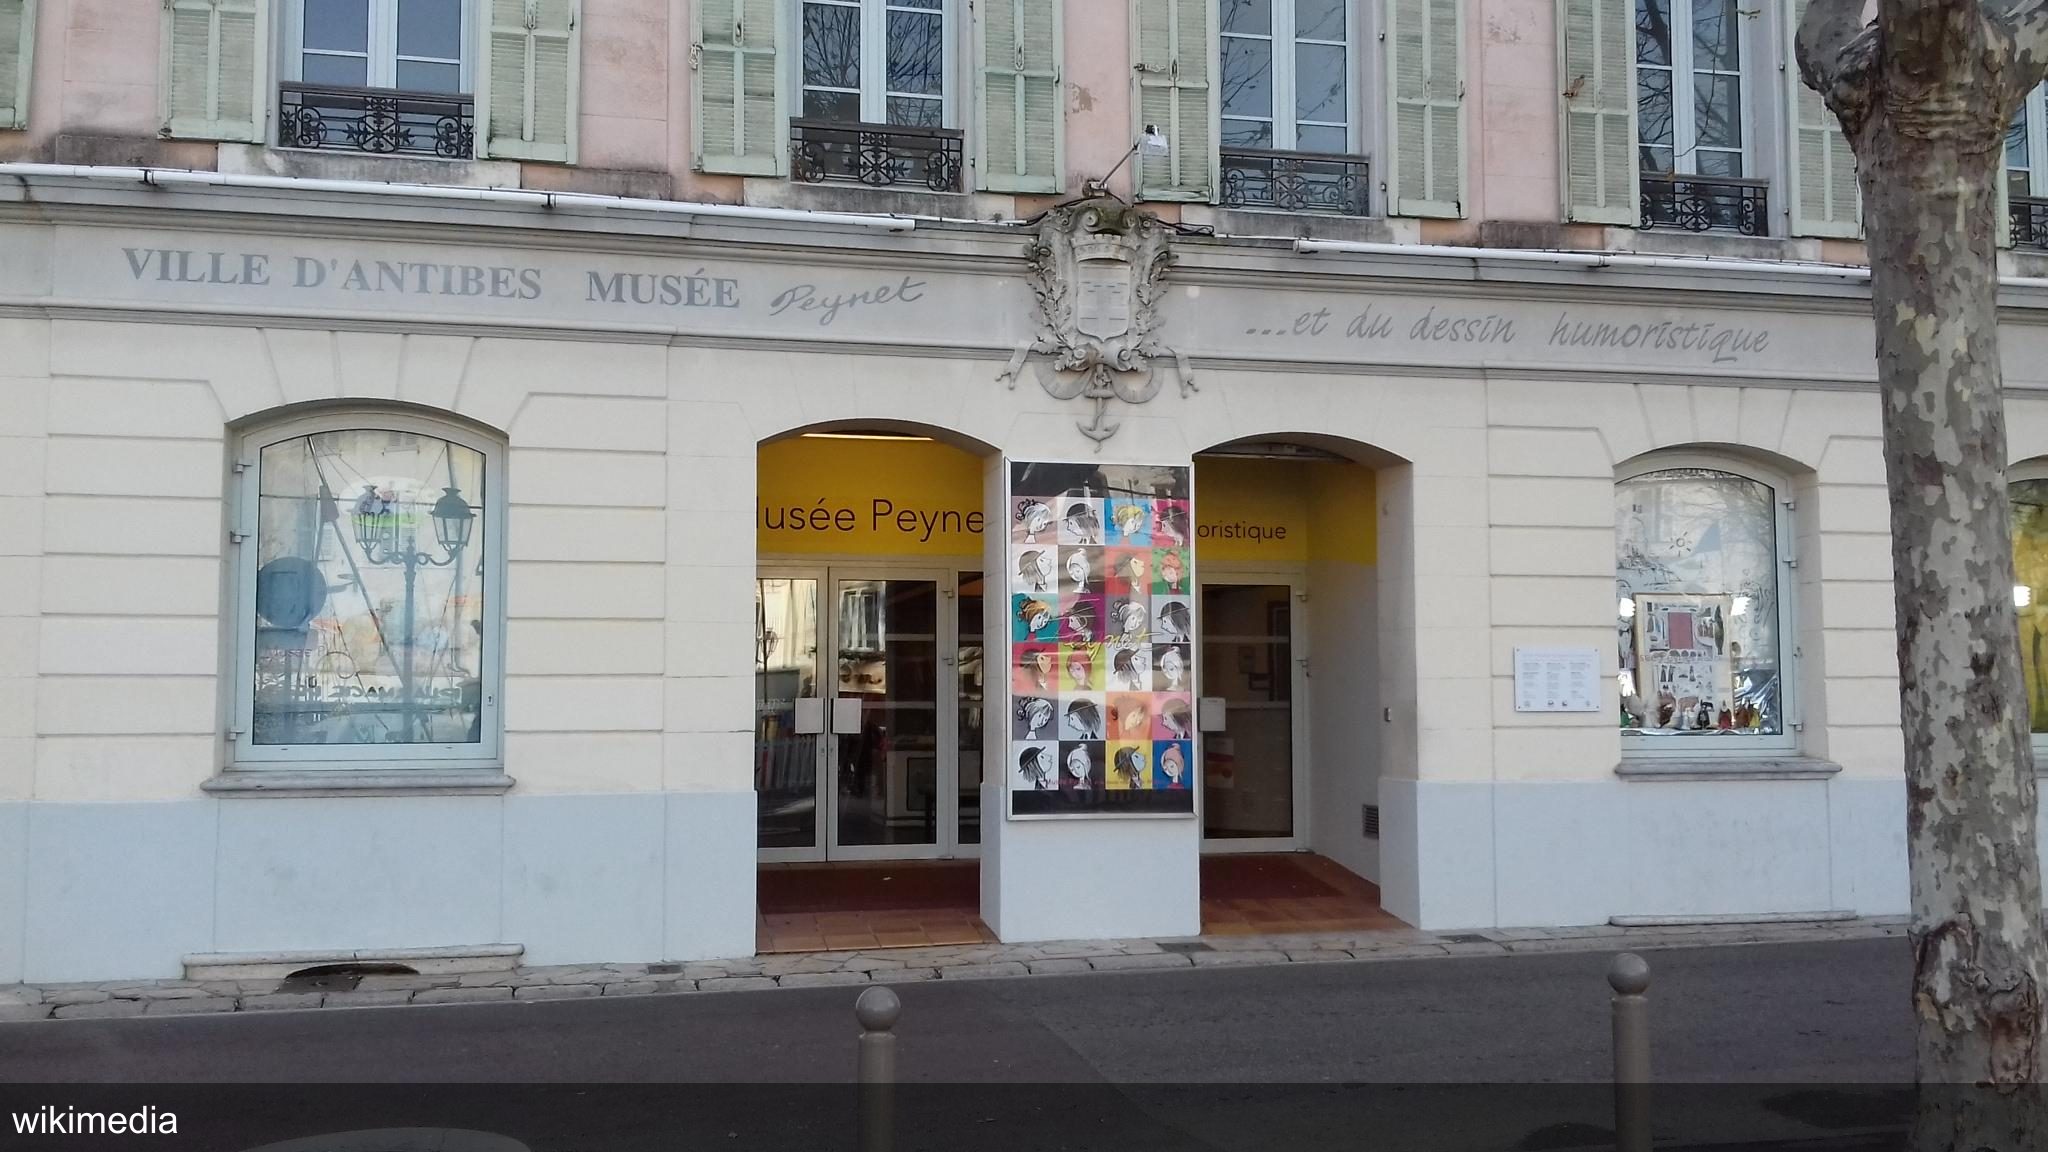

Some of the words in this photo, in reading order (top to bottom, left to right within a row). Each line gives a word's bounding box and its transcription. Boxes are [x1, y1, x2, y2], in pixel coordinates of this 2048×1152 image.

[121, 247, 270, 285] VILLE
[293, 256, 542, 300] D'ANTIBES
[585, 268, 741, 309] MUSÉE
[769, 276, 927, 326] Peynet
[1346, 303, 1393, 339] du
[1409, 305, 1516, 344] dessin
[1549, 311, 1770, 363] humoristique
[756, 497, 856, 532] usée
[1197, 520, 1287, 544] oristique
